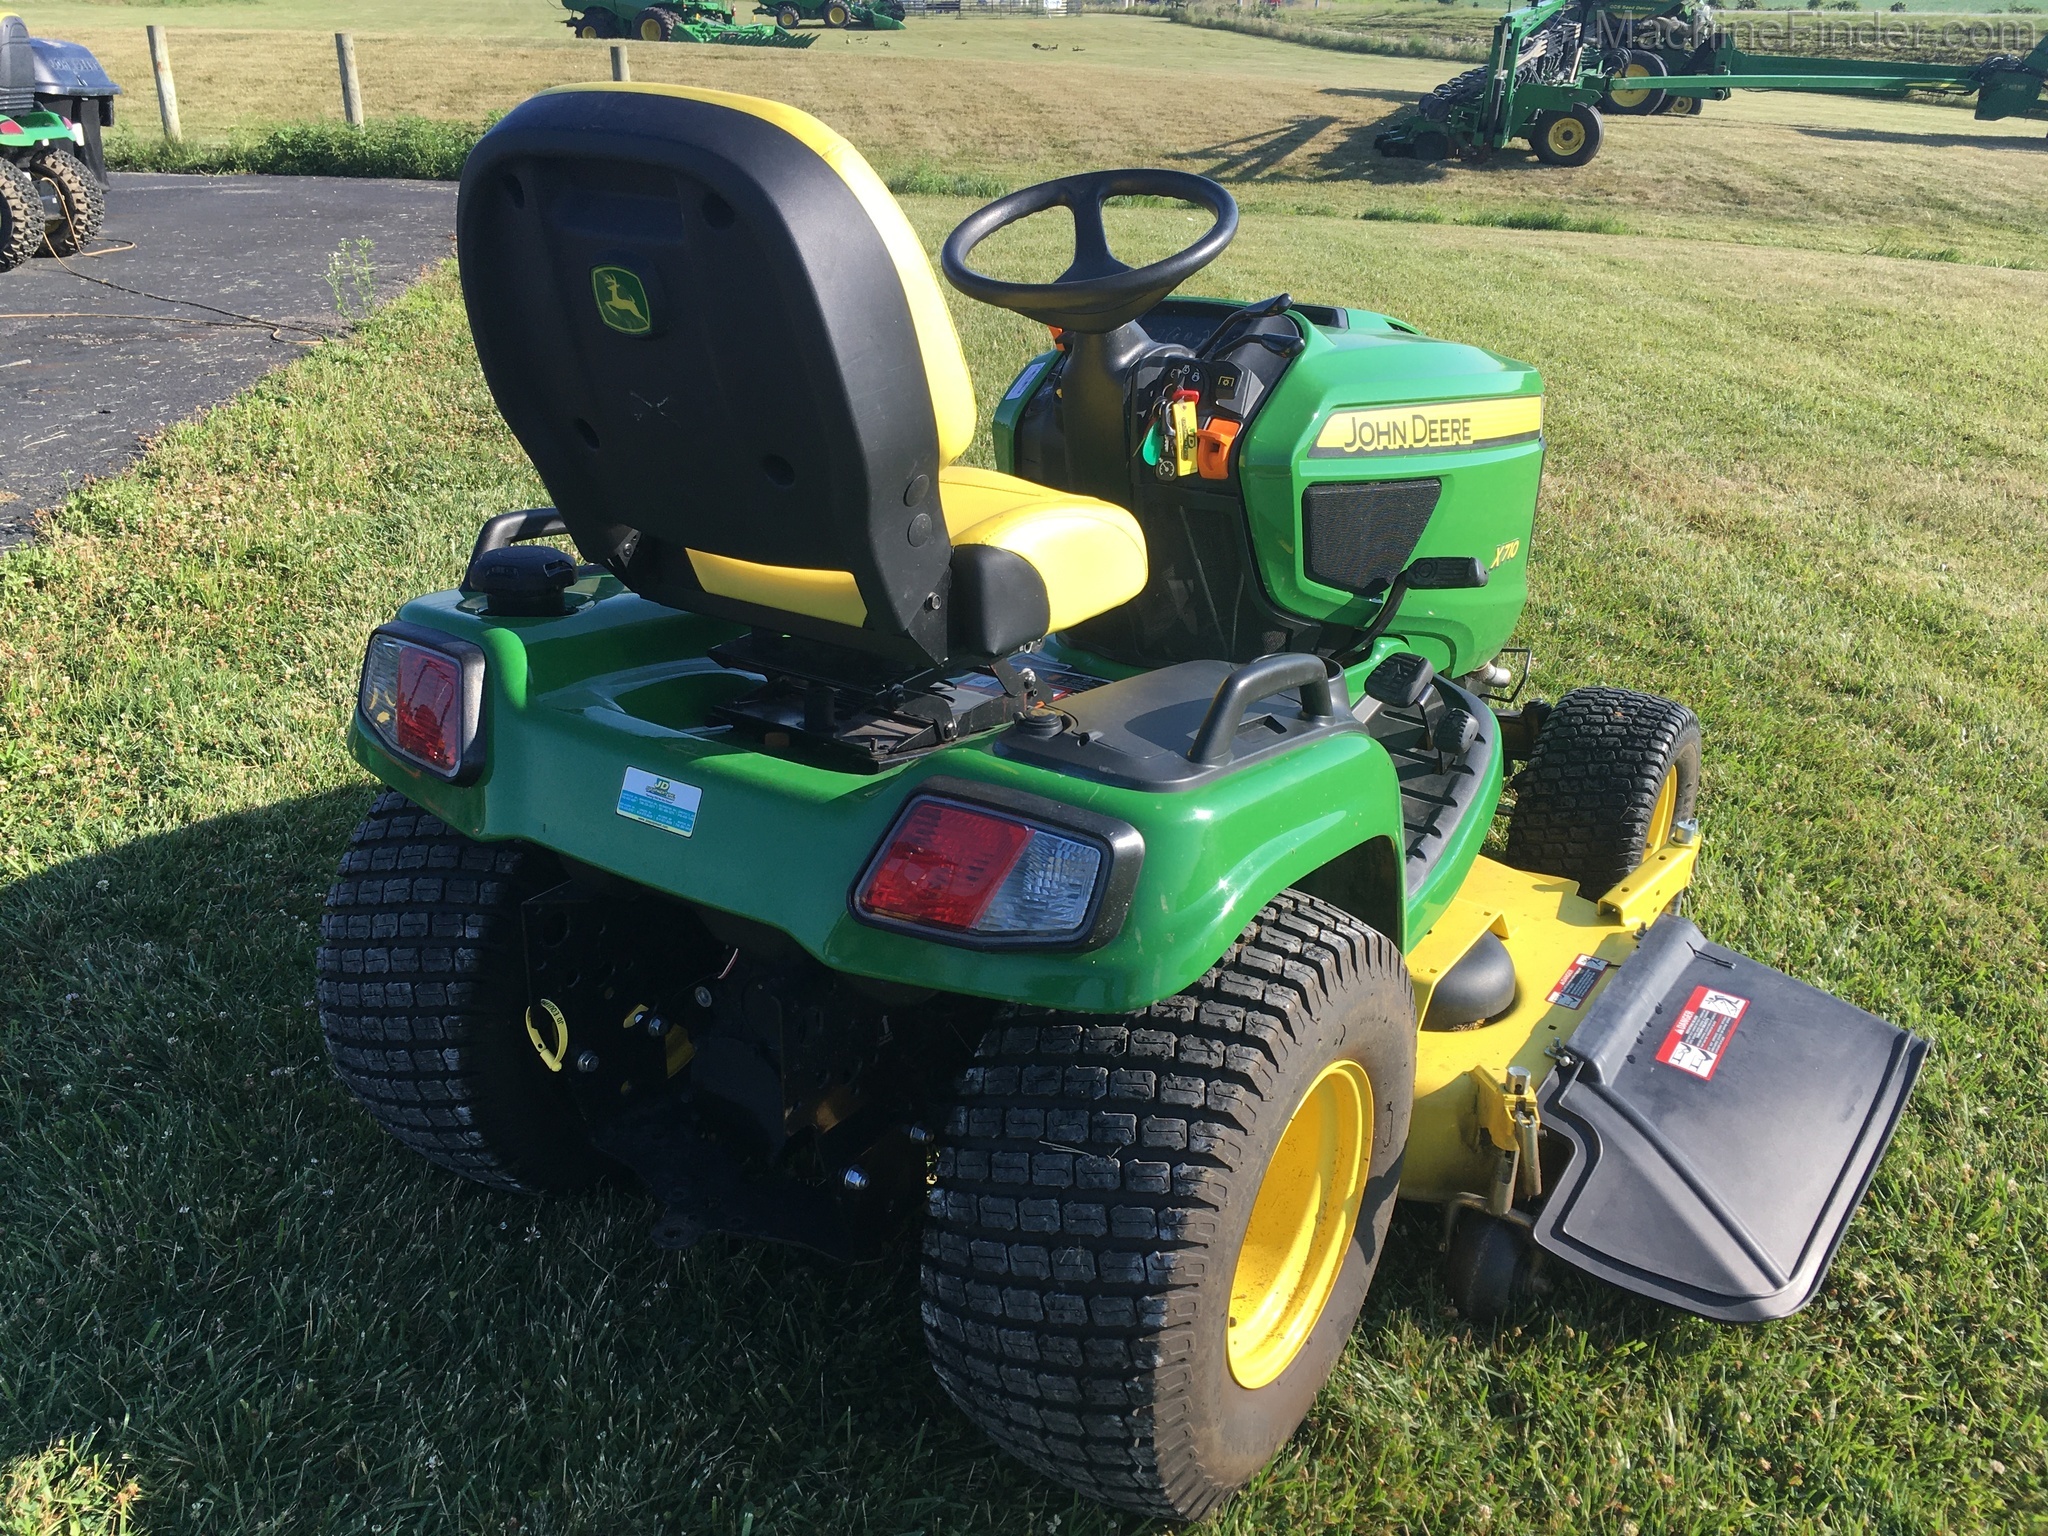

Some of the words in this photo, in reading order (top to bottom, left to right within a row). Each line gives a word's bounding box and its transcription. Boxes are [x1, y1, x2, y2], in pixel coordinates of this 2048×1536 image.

[1344, 416, 1407, 448] JOHN
[1412, 414, 1472, 444] DEERE
[1490, 539, 1520, 569] X710
[654, 779, 670, 790] JD
[1678, 1009, 1695, 1032] DANGER
